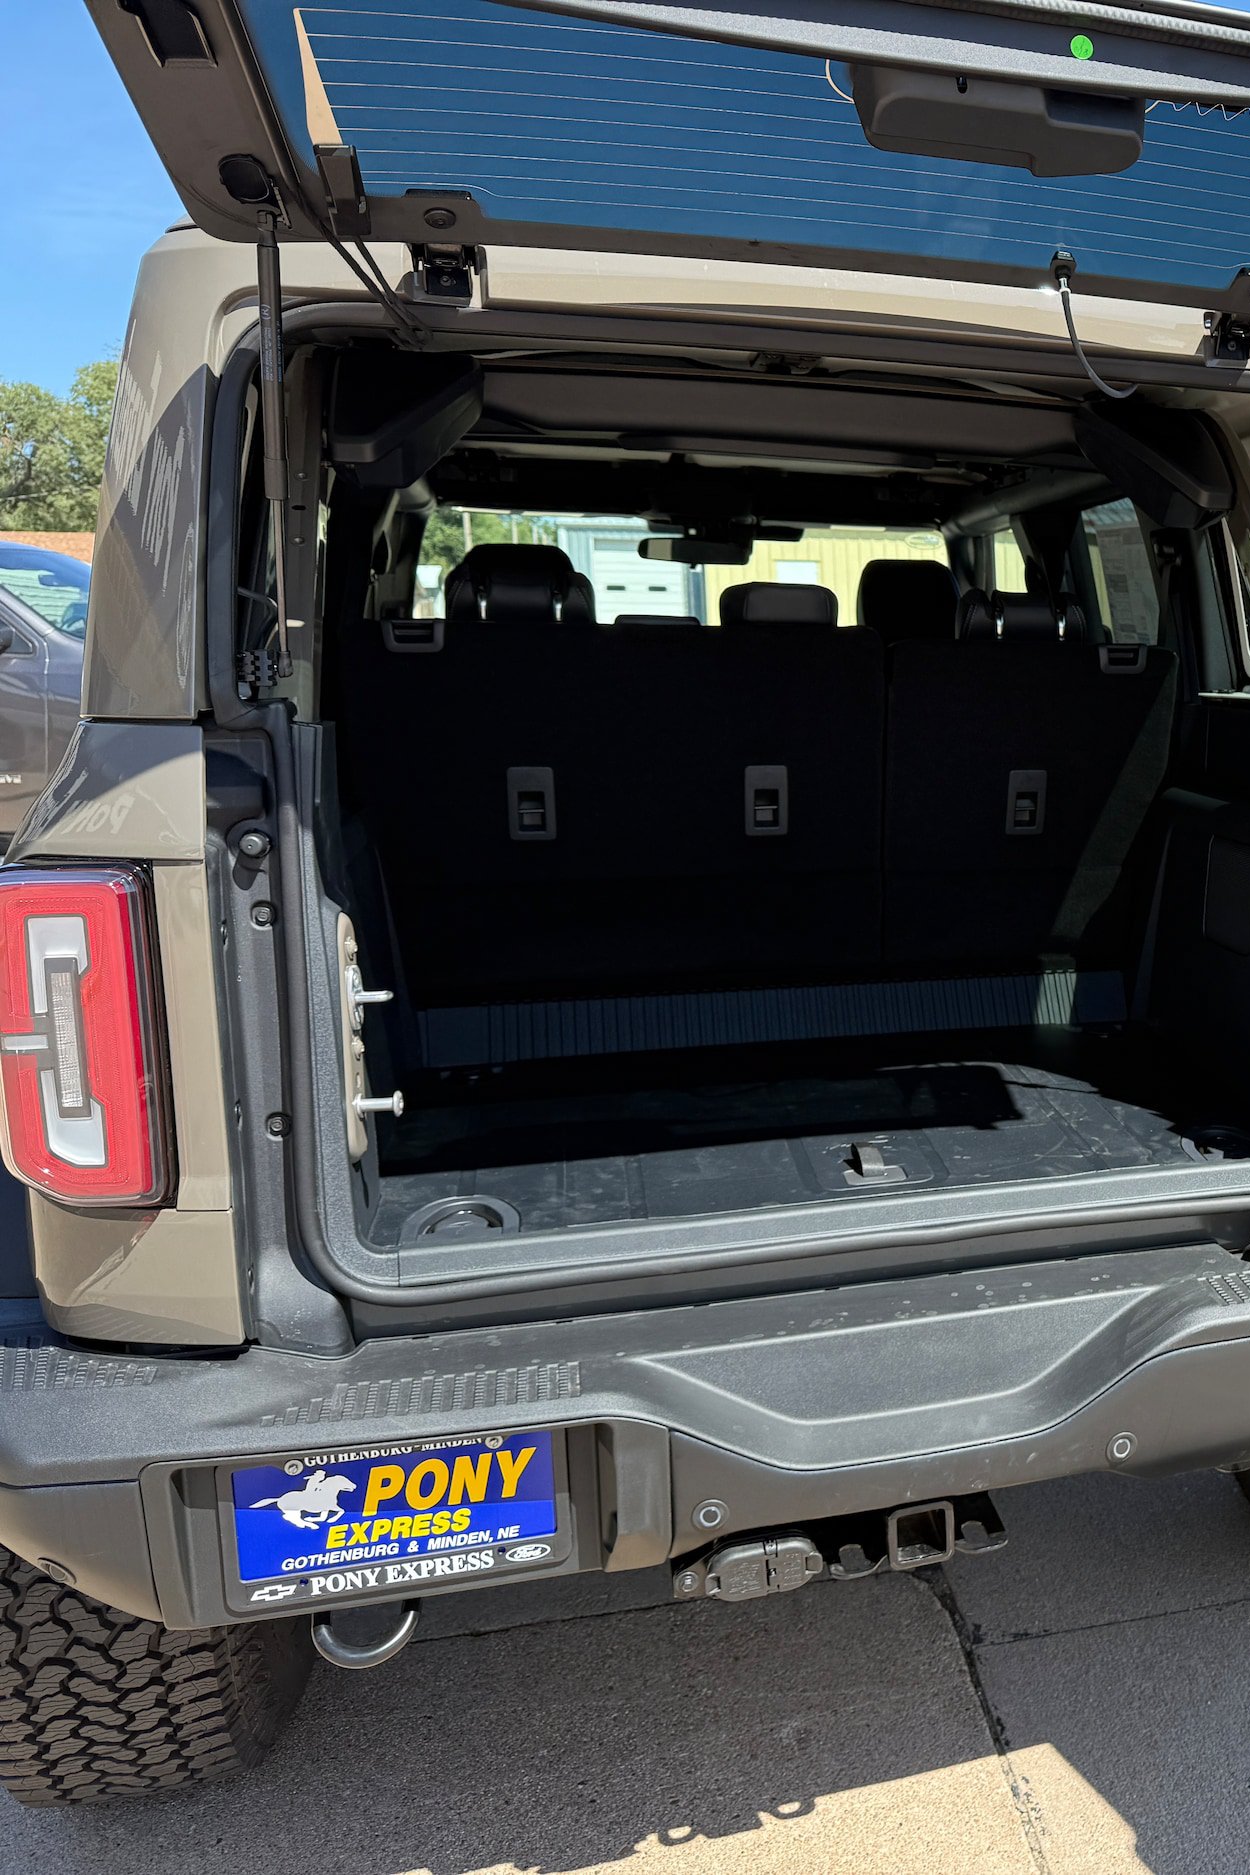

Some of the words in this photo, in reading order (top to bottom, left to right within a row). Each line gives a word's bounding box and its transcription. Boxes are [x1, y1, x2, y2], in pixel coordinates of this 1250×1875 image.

[363, 1447, 537, 1517] PONY
[281, 1541, 400, 1571] GOTHENBURG
[406, 1540, 420, 1554] &
[427, 1532, 494, 1552] MINDEN,
[497, 1525, 521, 1540] NE
[326, 1509, 472, 1549] EXPRESS
[310, 1566, 386, 1596] PONY
[385, 1549, 495, 1585] EXPRESS
